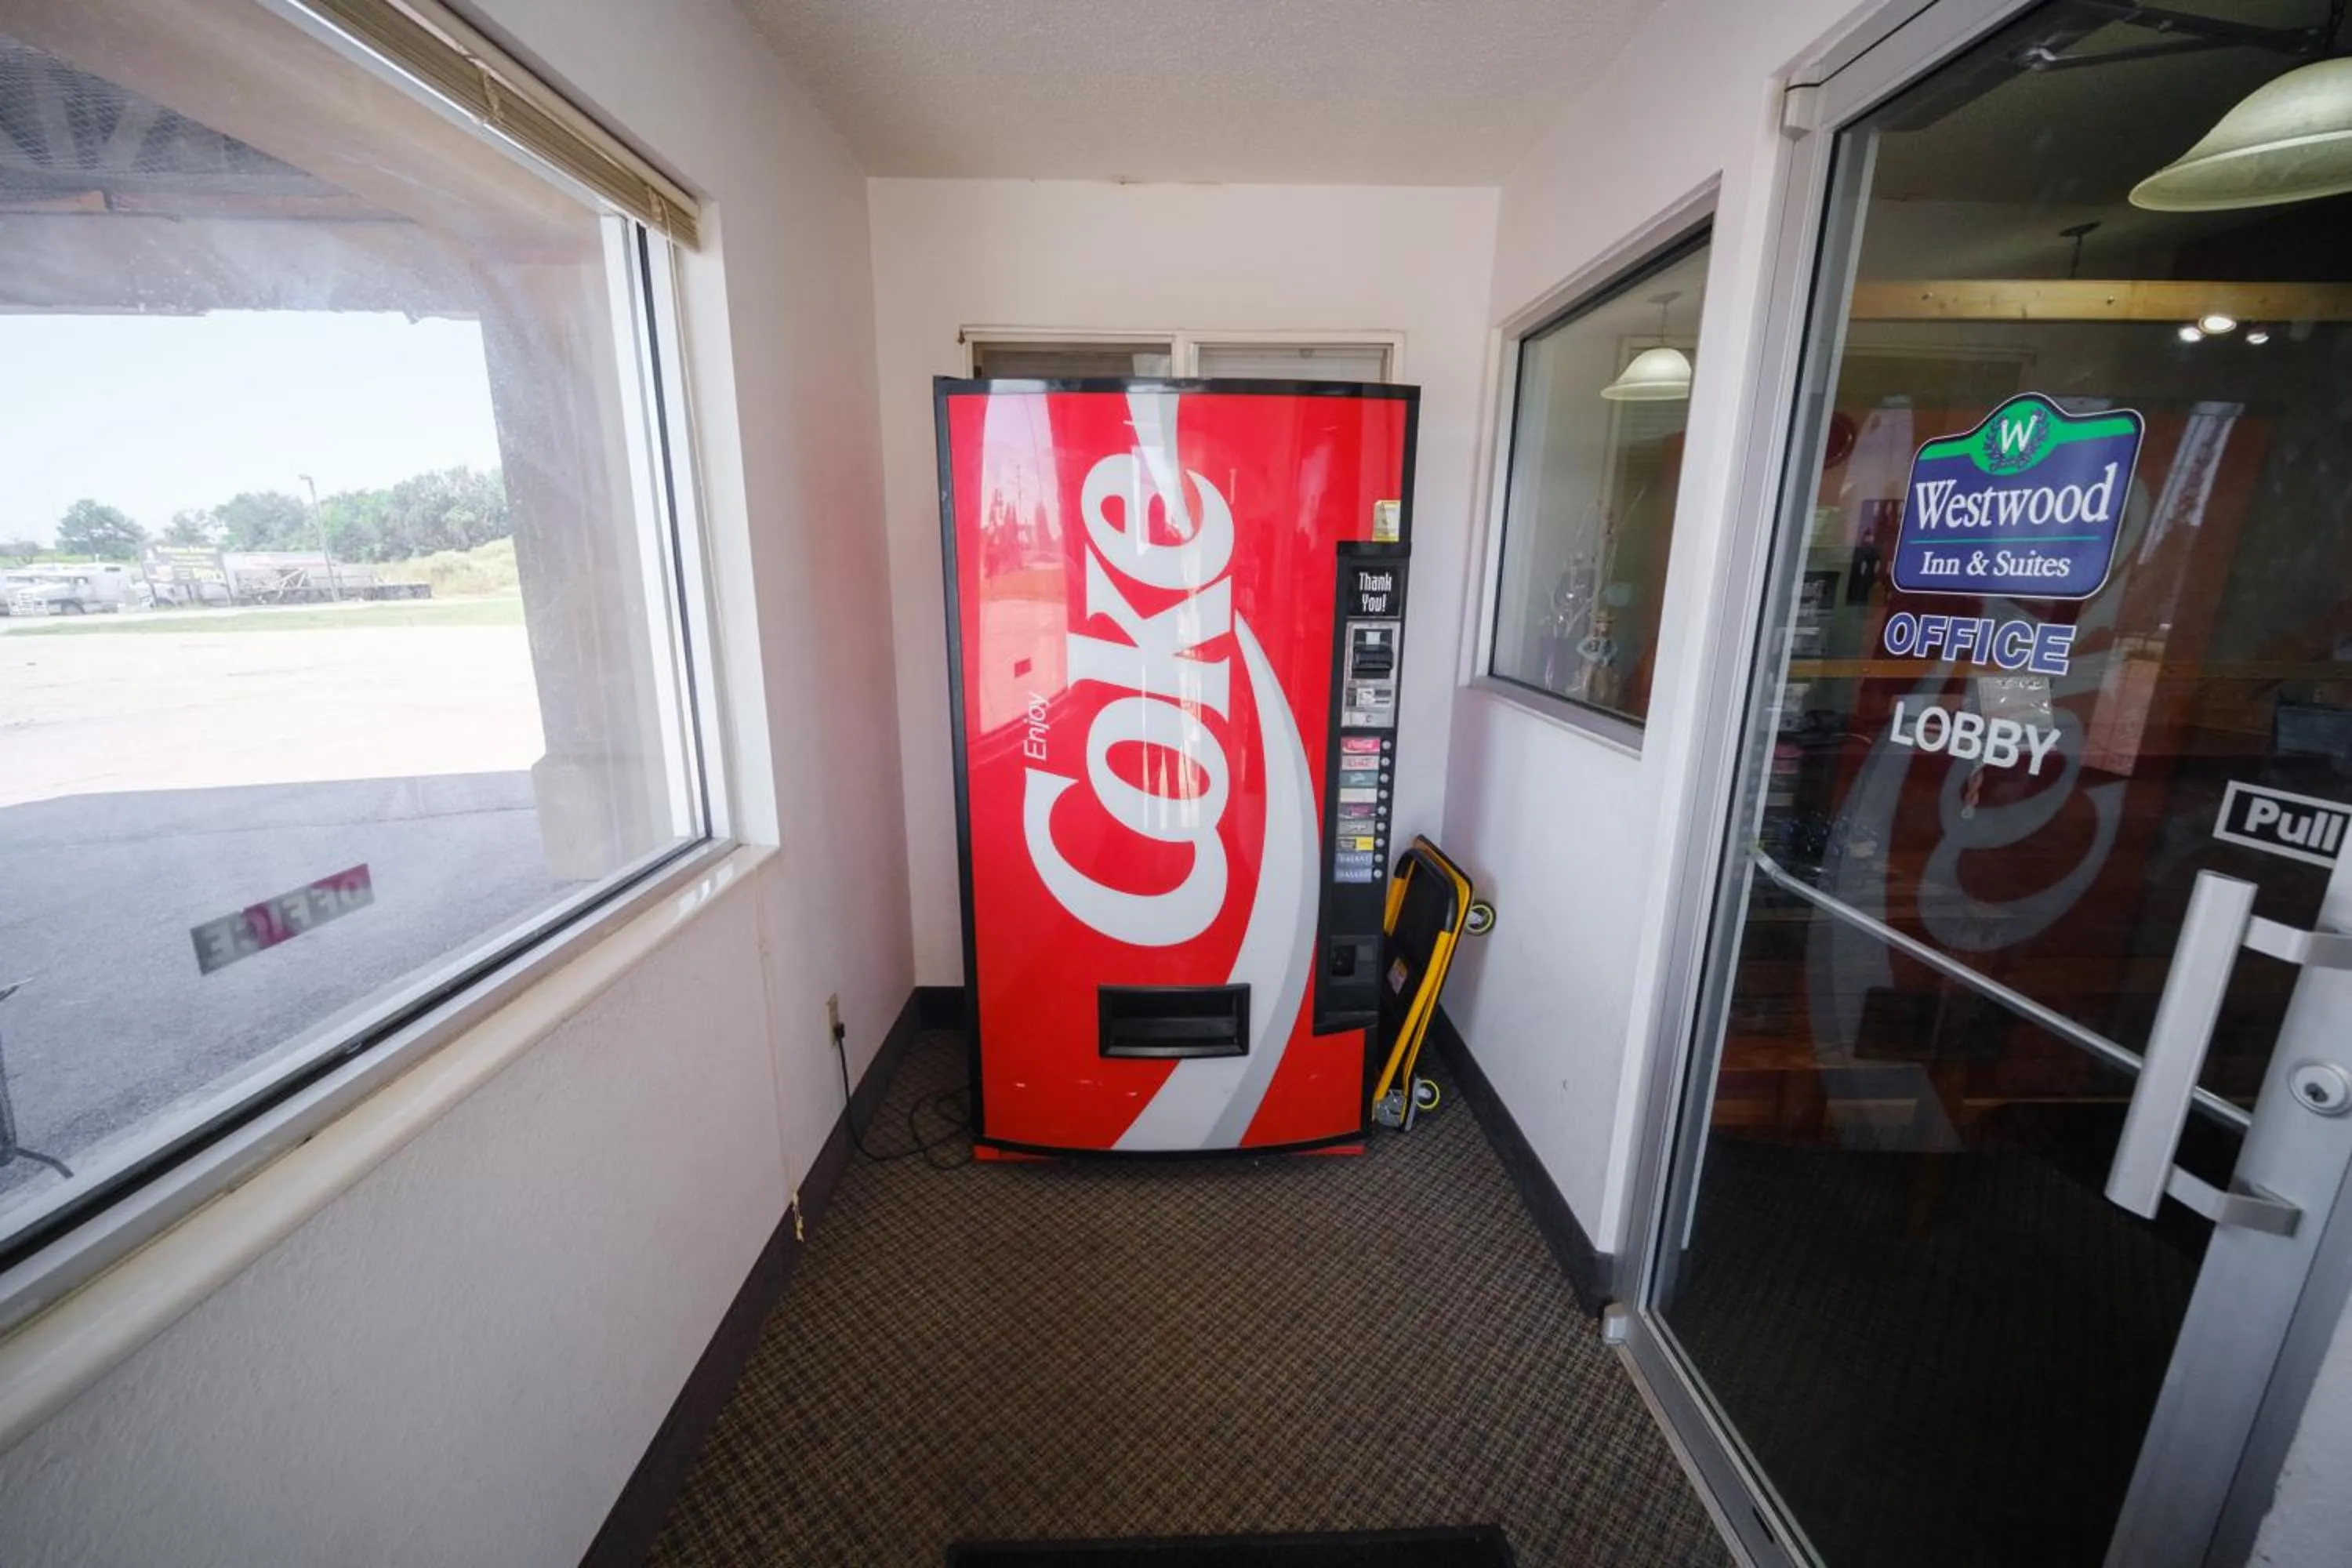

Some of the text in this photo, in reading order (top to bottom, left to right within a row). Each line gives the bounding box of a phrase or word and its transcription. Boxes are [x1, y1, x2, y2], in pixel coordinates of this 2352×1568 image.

[1999, 414, 2038, 455] W
[1915, 462, 2118, 531] Westwood
[1359, 572, 1392, 591] Thank
[1919, 550, 2071, 578] Inn & Suites
[1362, 593, 1387, 612] You!
[1884, 612, 2077, 676] OFFICE
[1023, 453, 1235, 947] Coke
[1023, 691, 1051, 760] Enjoy
[1889, 700, 2062, 776] LOBBY
[2244, 796, 2345, 852] Pull
